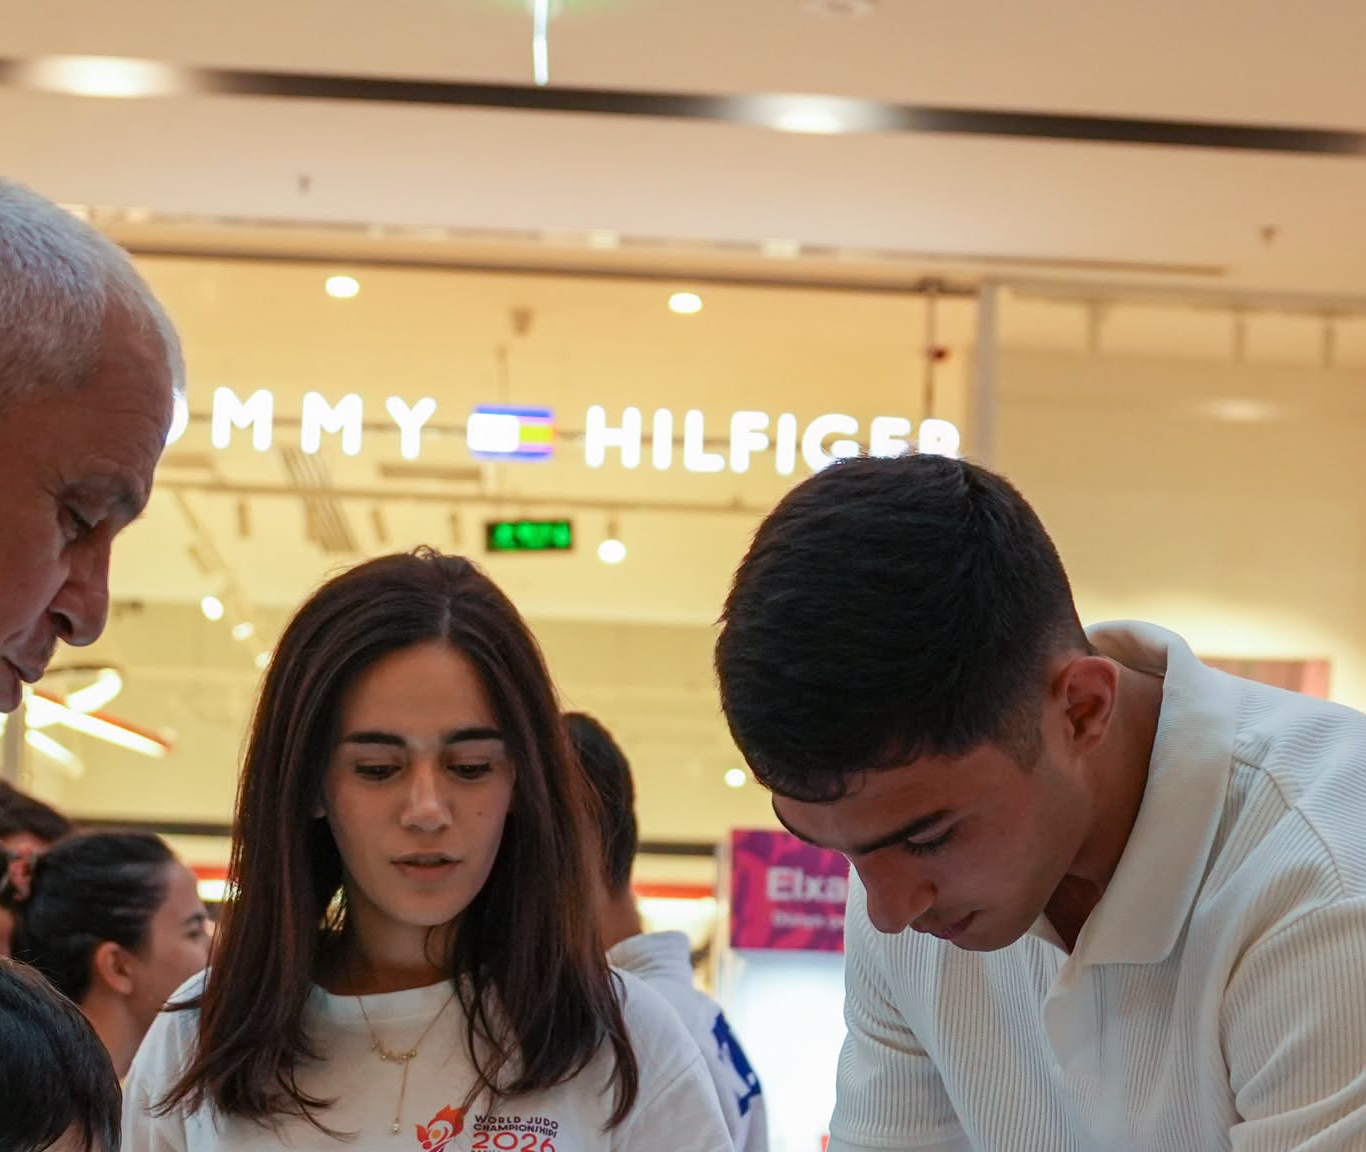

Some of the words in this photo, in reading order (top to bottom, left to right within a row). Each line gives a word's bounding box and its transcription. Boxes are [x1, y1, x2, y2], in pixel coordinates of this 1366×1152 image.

[585, 405, 962, 475] HILFIGER
[474, 1115, 521, 1124] WORLD
[526, 1116, 558, 1130] JUDO
